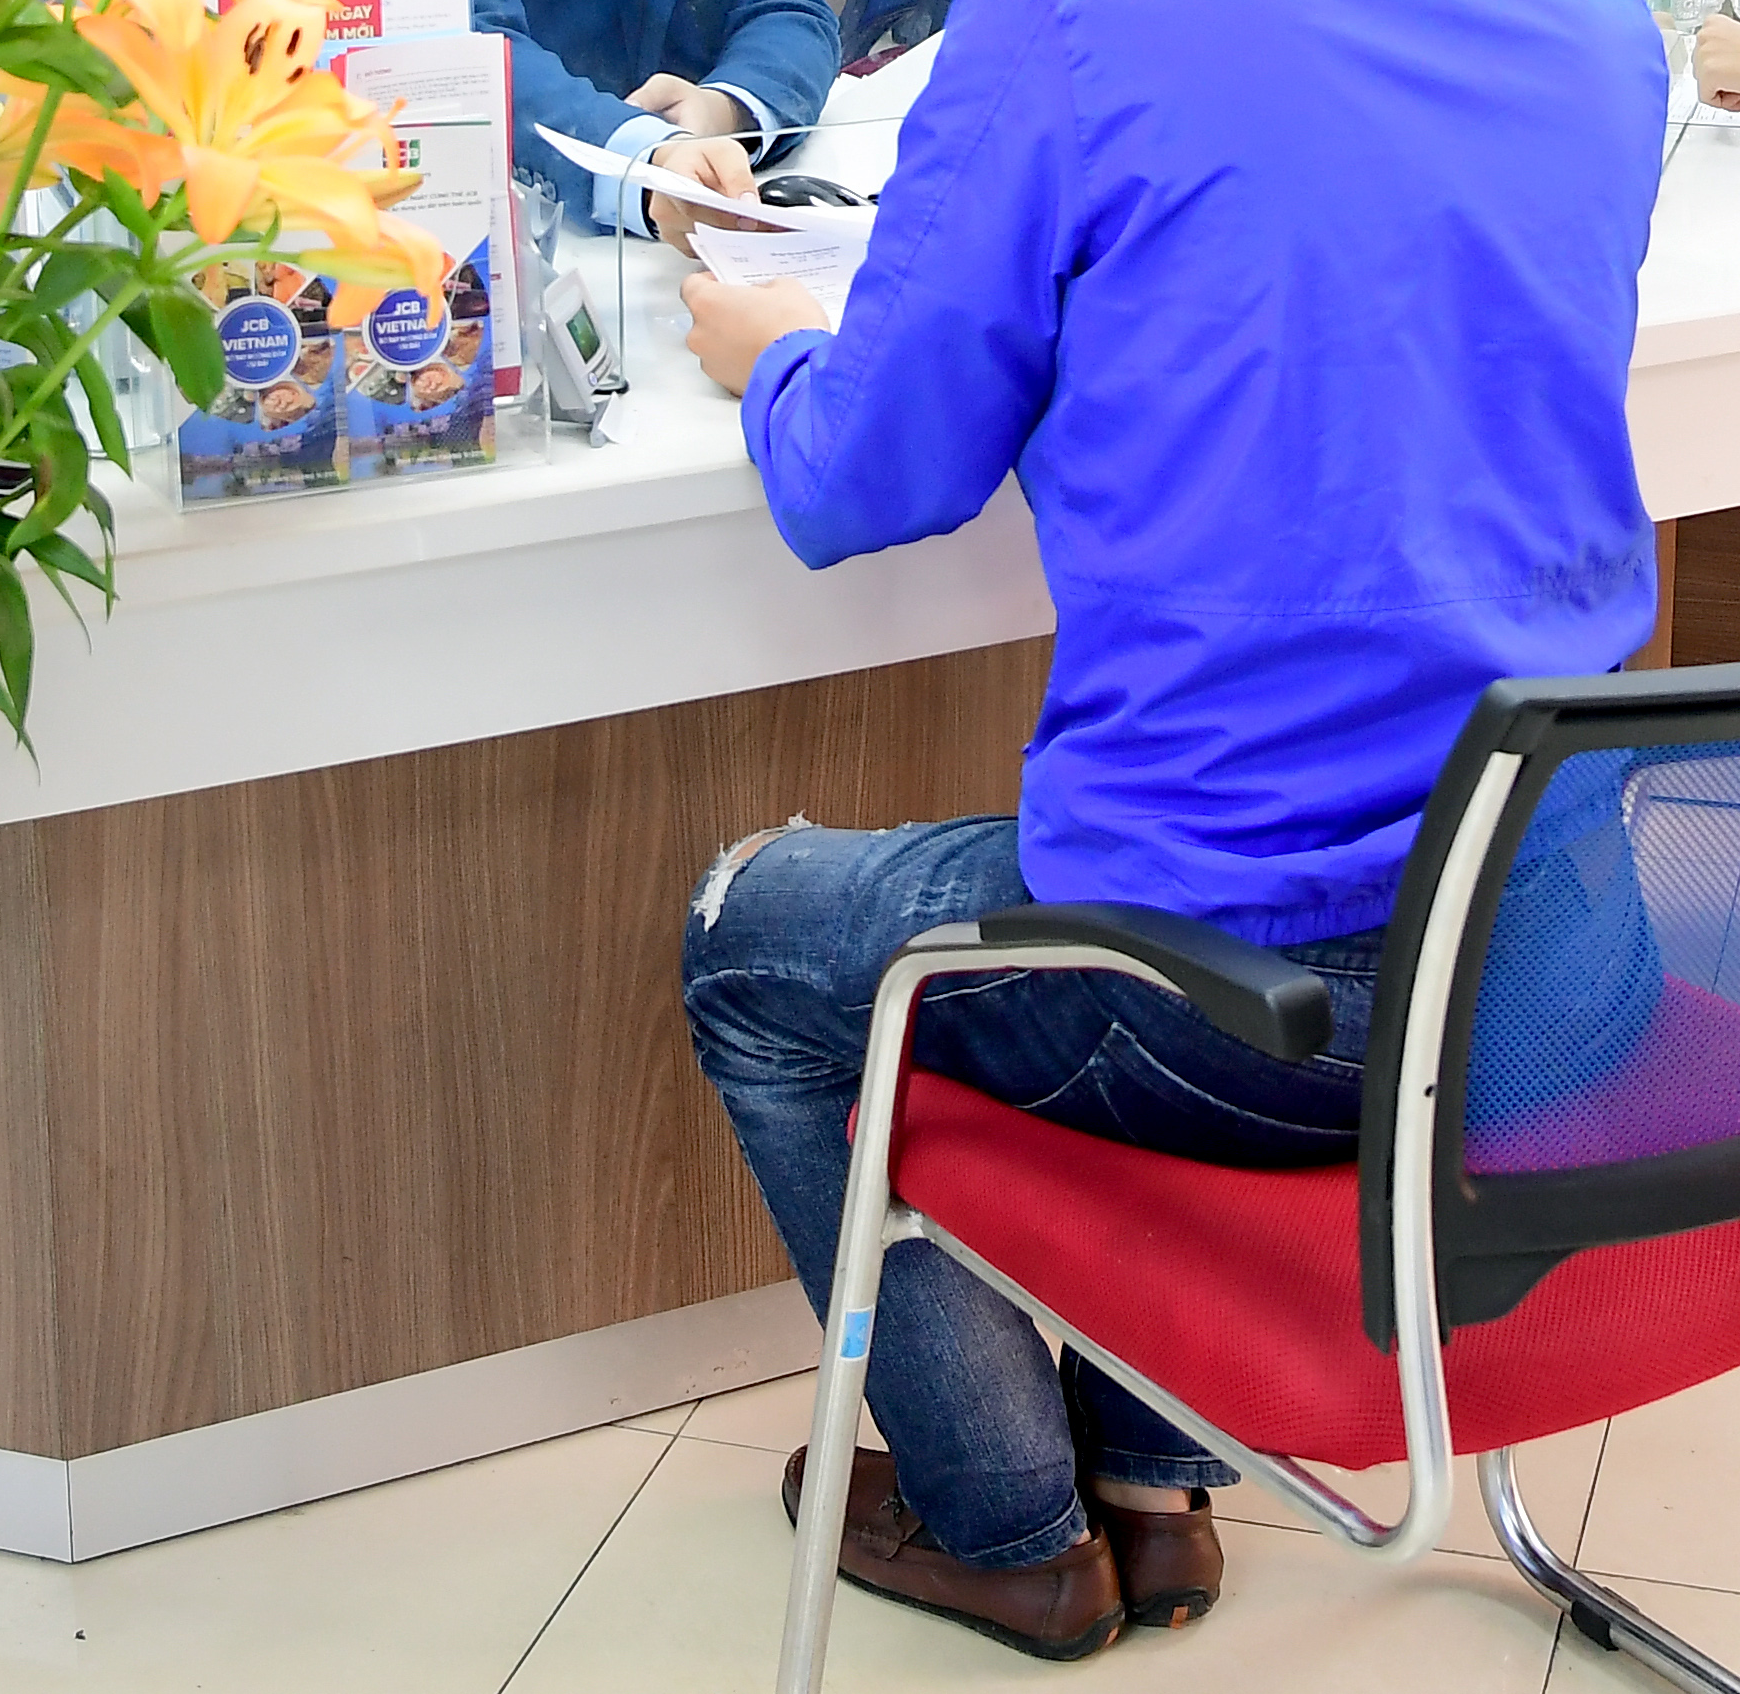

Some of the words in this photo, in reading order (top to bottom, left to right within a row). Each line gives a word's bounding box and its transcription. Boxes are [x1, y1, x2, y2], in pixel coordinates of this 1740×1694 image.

[329, 4, 373, 21] NGAY
[394, 301, 420, 315] JCB
[240, 317, 269, 333] JCB
[375, 318, 427, 334] VIETNA
[222, 334, 288, 352] VIETNAM
